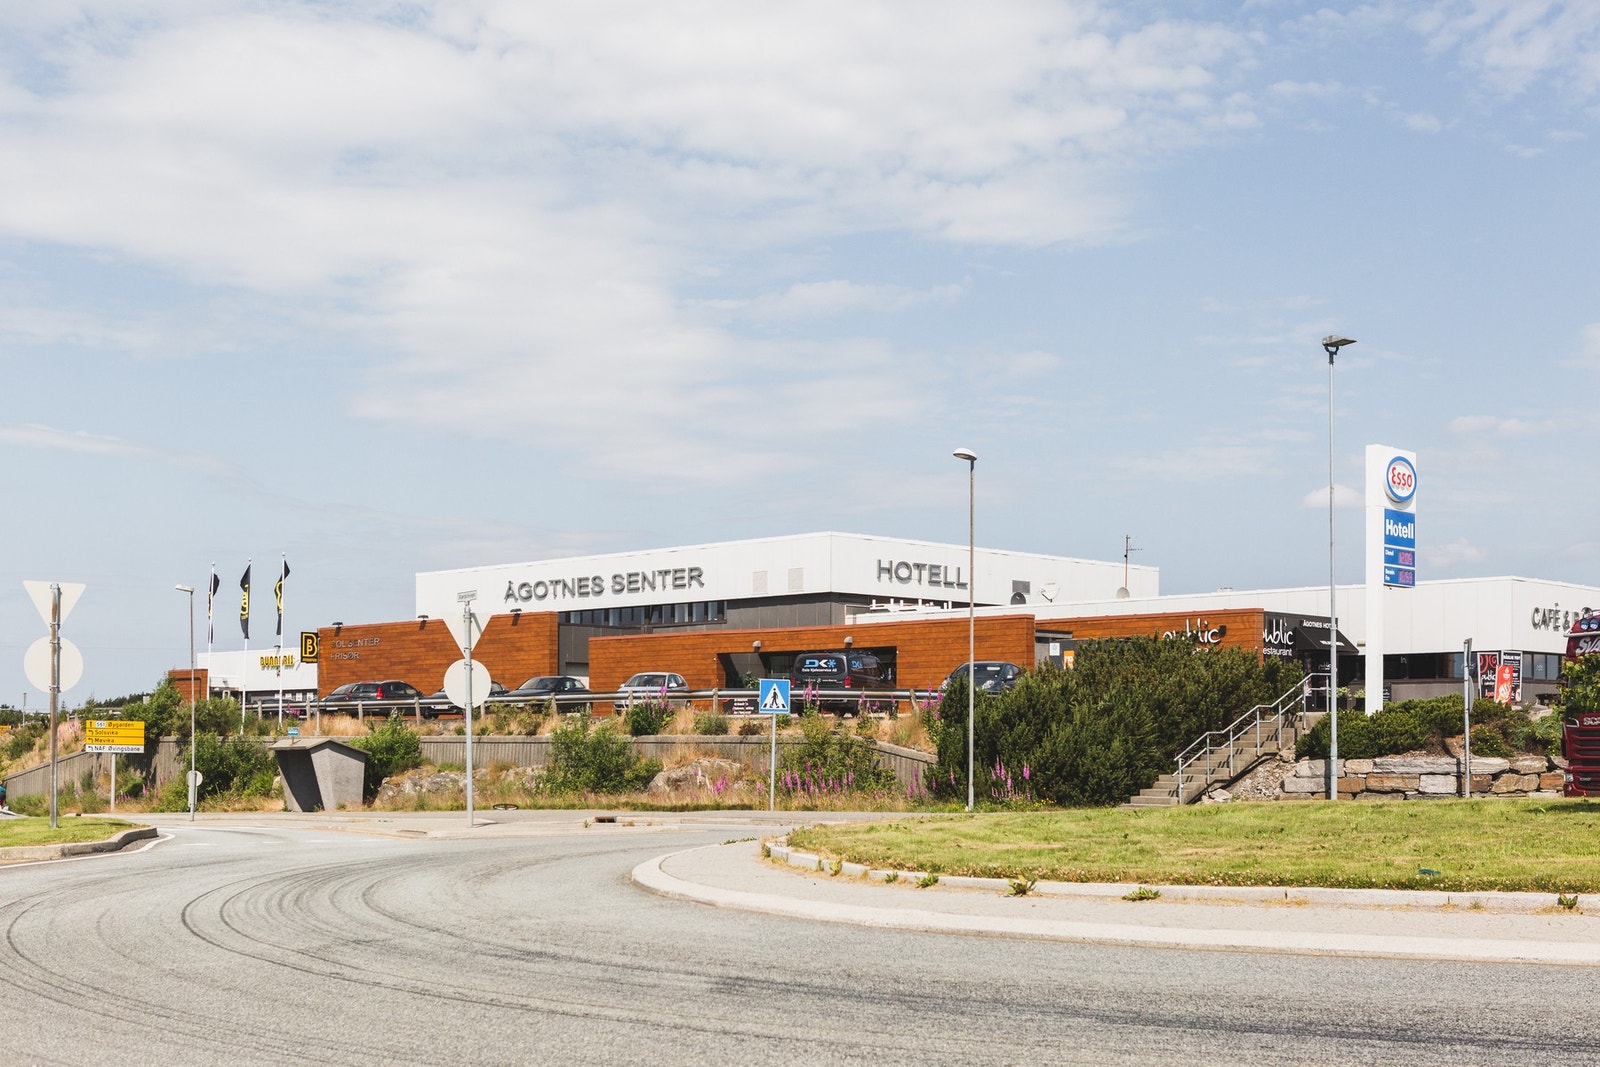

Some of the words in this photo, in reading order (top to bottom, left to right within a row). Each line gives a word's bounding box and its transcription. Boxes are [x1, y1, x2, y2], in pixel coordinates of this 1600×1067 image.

[1385, 518, 1414, 539] Hotell
[504, 575, 605, 603] ÅGOTNES
[611, 567, 706, 595] SENTER
[877, 559, 968, 590] HOTELL
[1263, 618, 1294, 645] ublic
[1562, 610, 1570, 632] &
[1263, 647, 1292, 656] estaurant
